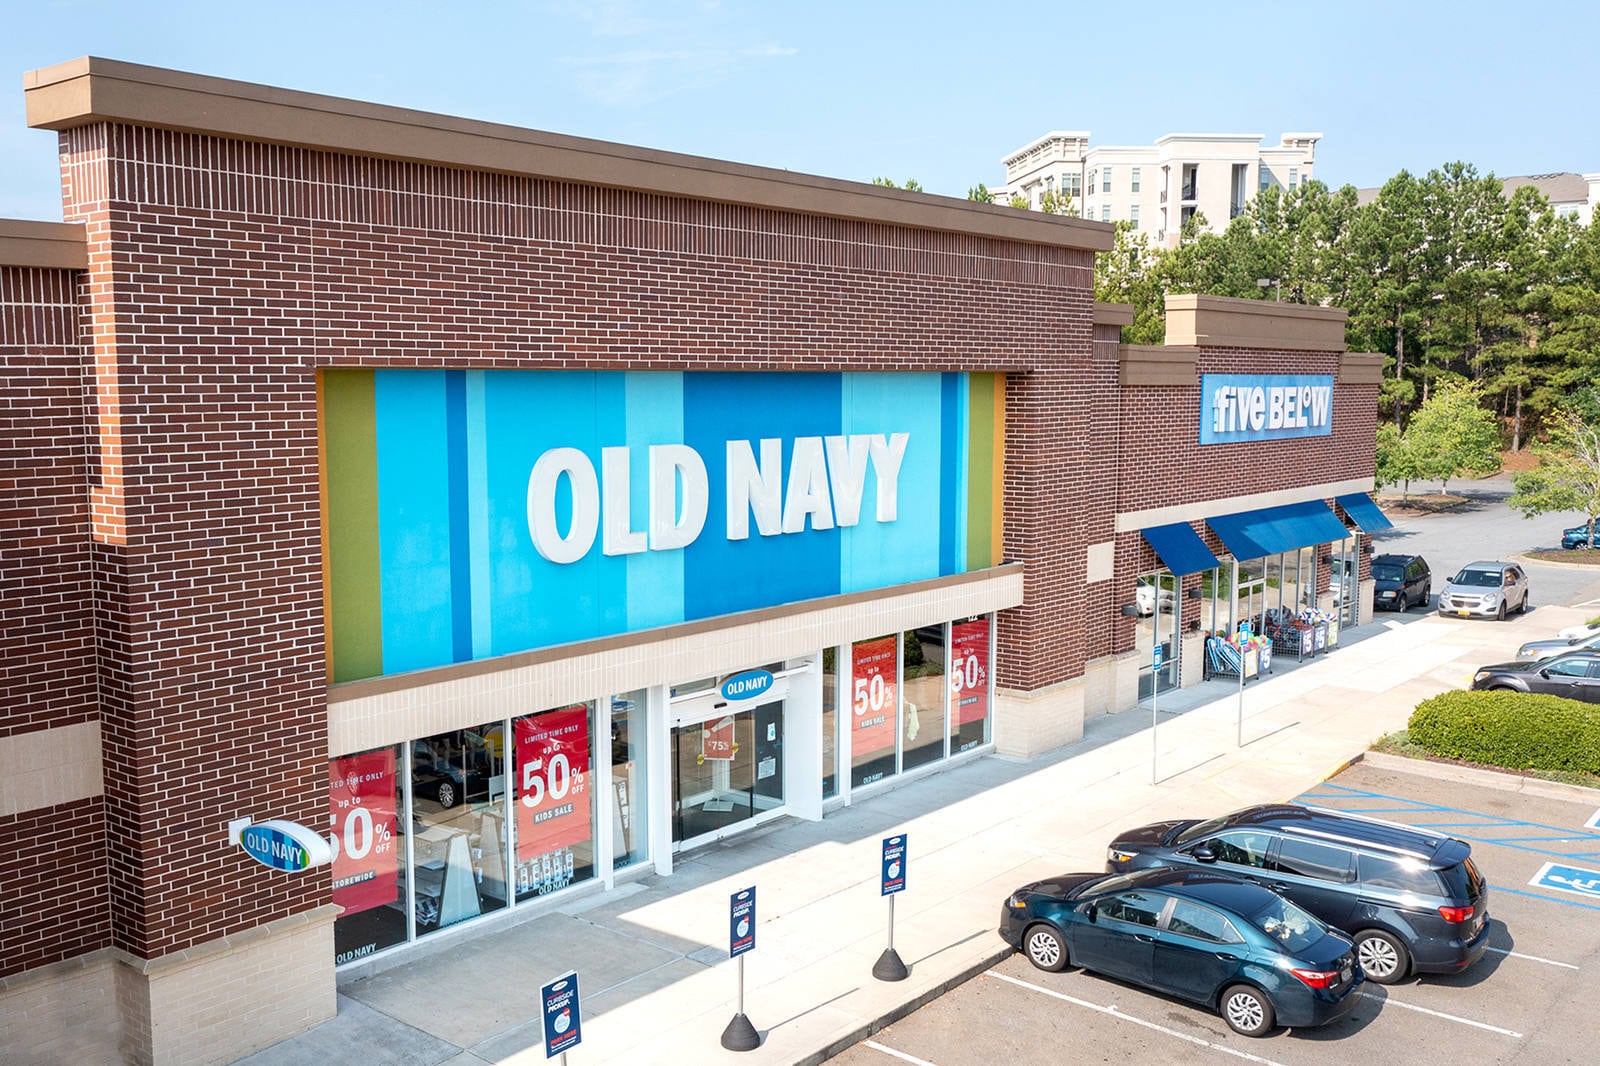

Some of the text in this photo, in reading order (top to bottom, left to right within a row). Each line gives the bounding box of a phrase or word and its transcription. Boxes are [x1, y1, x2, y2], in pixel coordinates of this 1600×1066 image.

[1213, 385, 1265, 432] five
[526, 432, 910, 564] OLD NAVY
[727, 675, 767, 695] OLD NAVY
[524, 724, 579, 744] LIMITED TIME ONLY
[365, 771, 384, 782] ONLY
[571, 784, 585, 795] OFF
[338, 797, 361, 808] up to
[534, 803, 573, 823] KIDS SALE
[247, 833, 302, 864] OLD NAVY
[375, 842, 391, 854] OFF
[538, 879, 570, 896] OLD NAVY
[336, 942, 377, 964] OLD NAVY
[546, 989, 574, 1007] CURBSIDE
